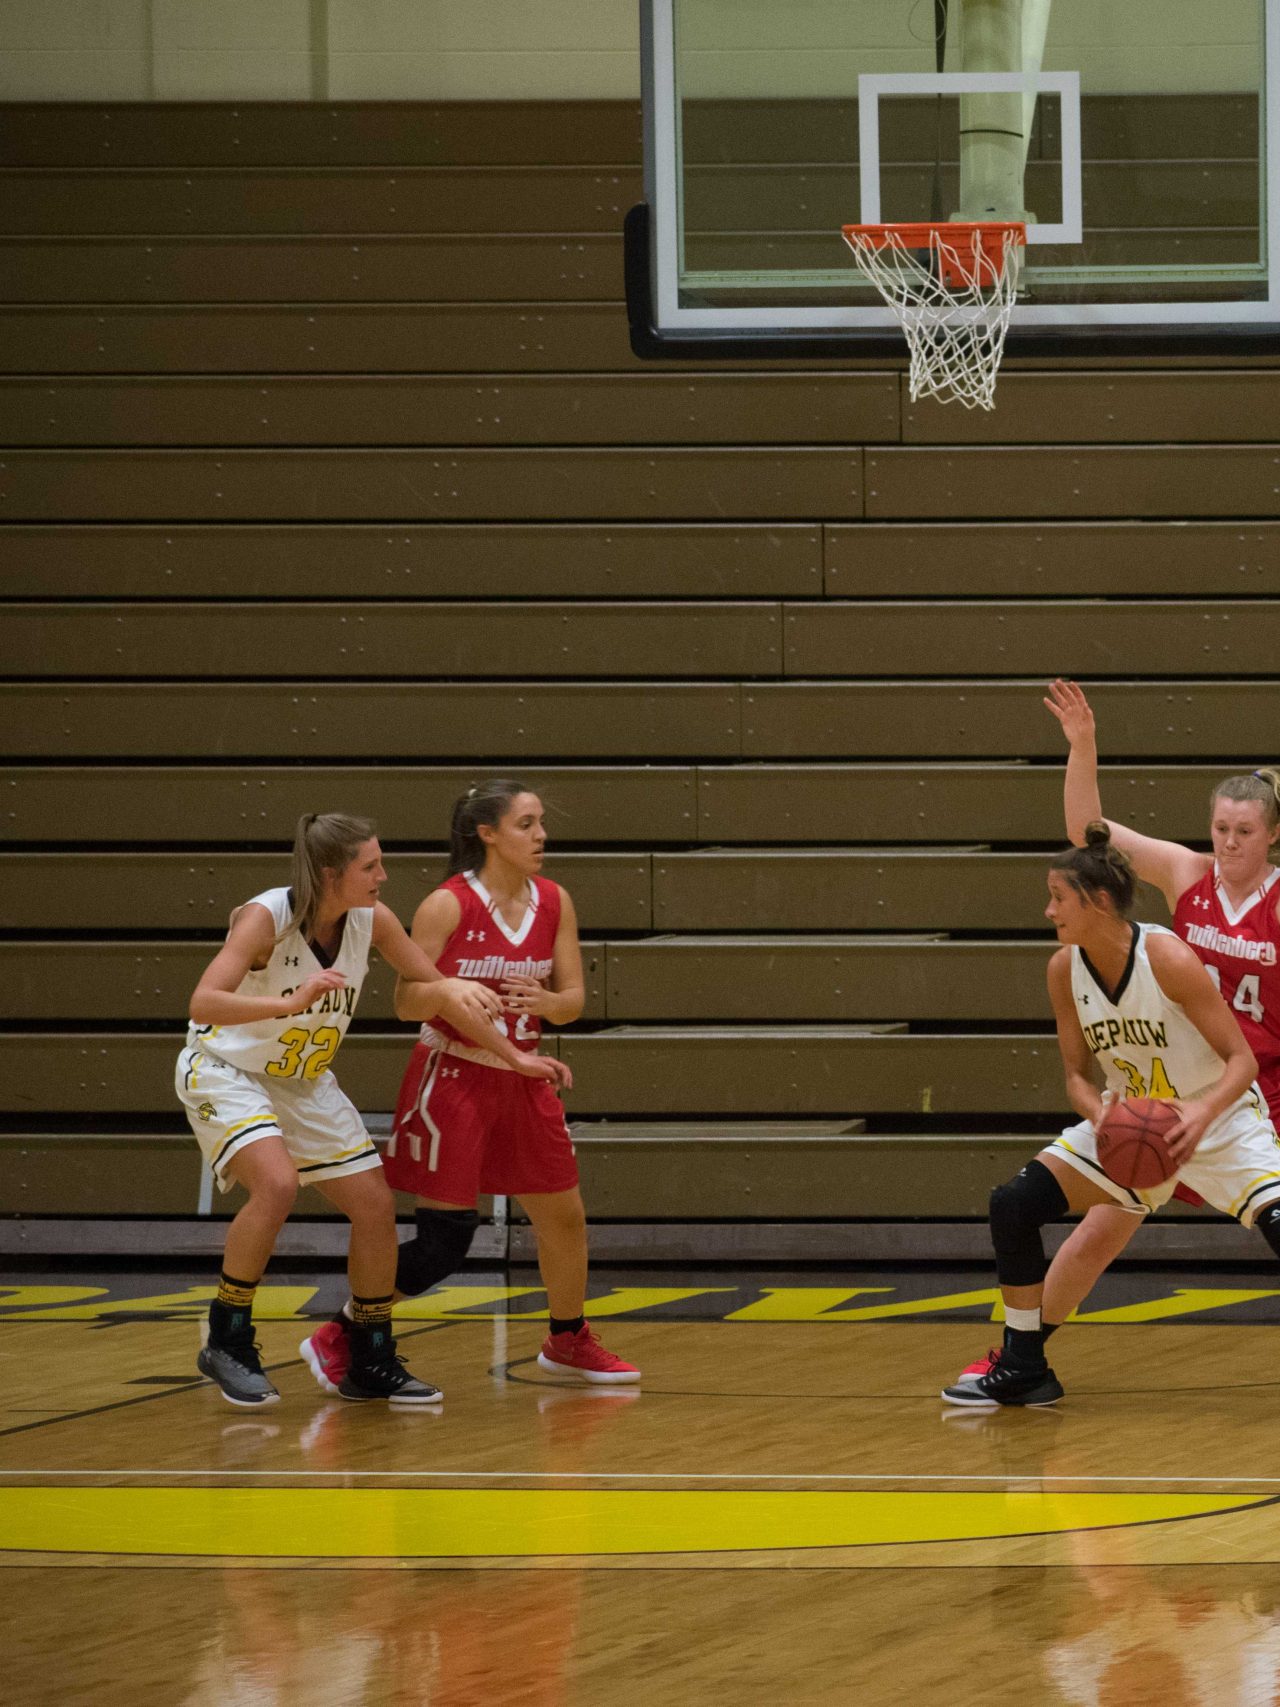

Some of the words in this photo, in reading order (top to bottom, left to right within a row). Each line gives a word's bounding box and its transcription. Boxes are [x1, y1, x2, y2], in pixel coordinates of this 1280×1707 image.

[1185, 922, 1278, 967] Wittenberg
[264, 1025, 341, 1081] 32
[1083, 1017, 1169, 1055] DEPAUW
[1113, 1056, 1181, 1100] 34
